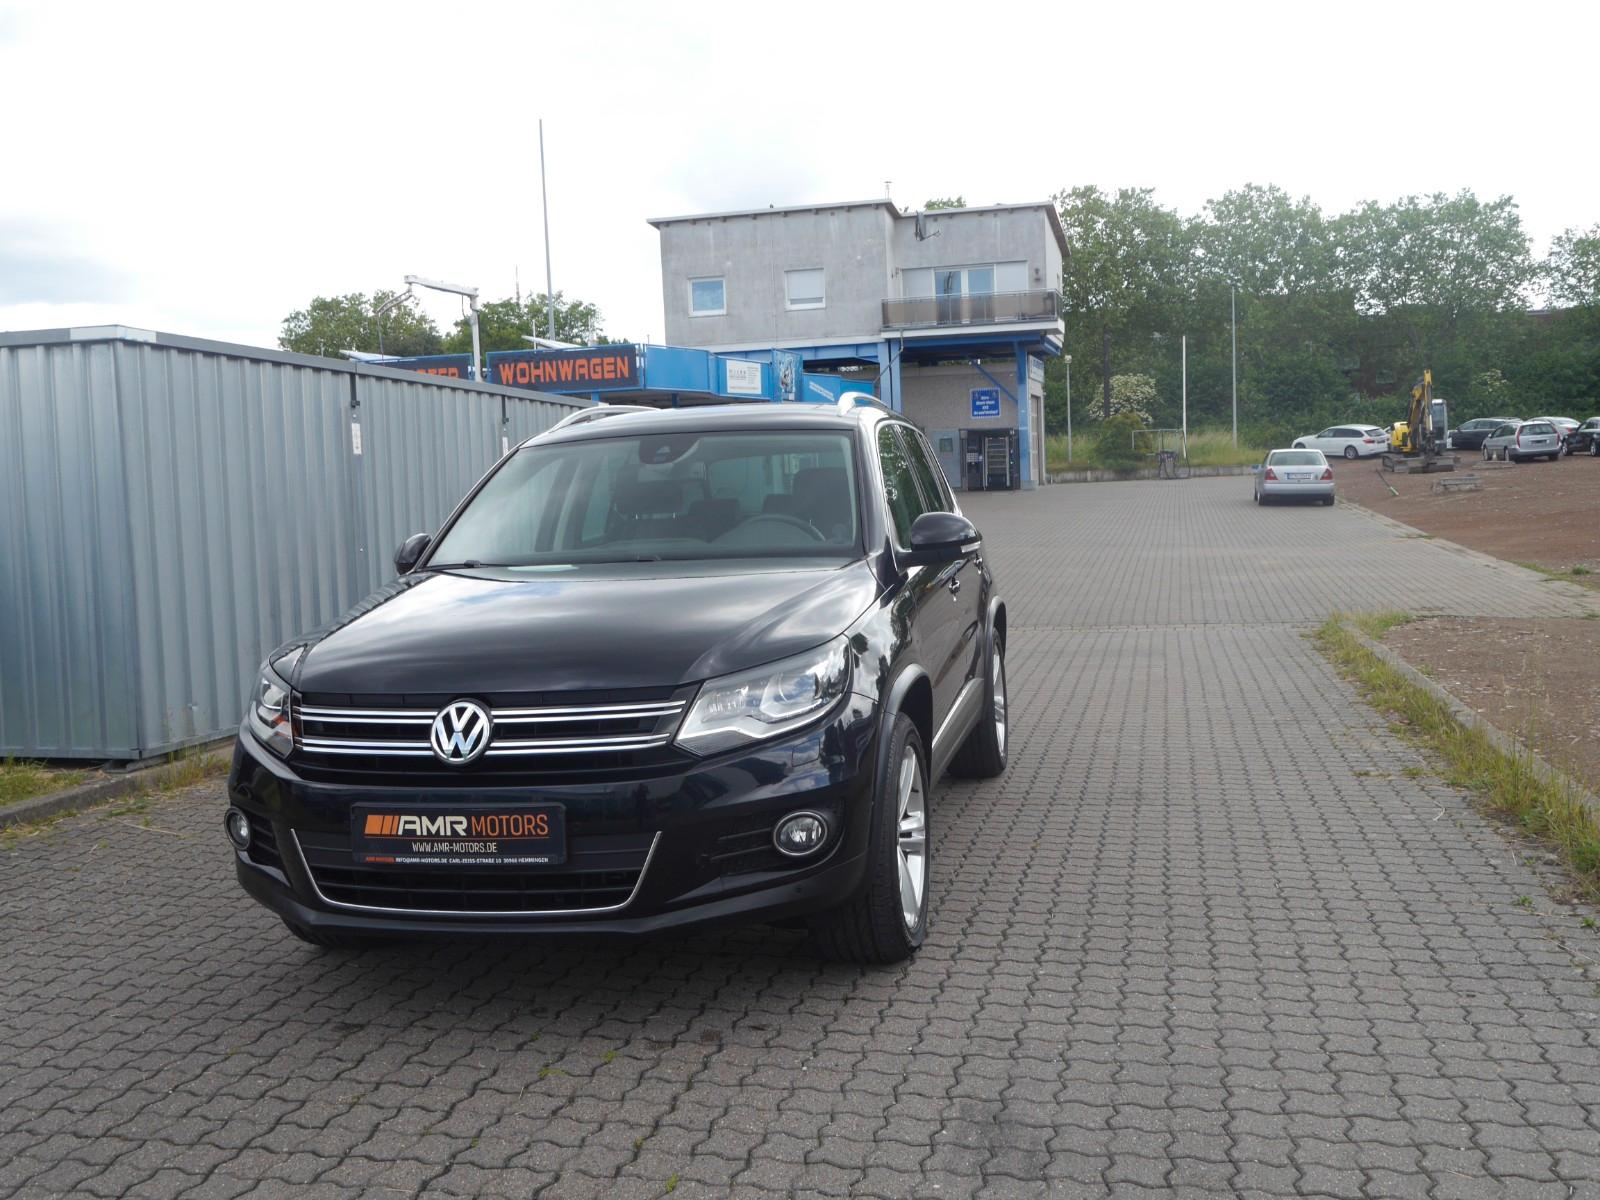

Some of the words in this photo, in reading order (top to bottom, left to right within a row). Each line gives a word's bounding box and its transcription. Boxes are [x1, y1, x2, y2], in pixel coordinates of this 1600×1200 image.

[499, 356, 629, 385] WOHNWAGEN
[398, 815, 467, 836] AMR
[472, 814, 548, 836] MOTORS
[412, 842, 497, 853] WWW.AMR-MOTORS.DE
